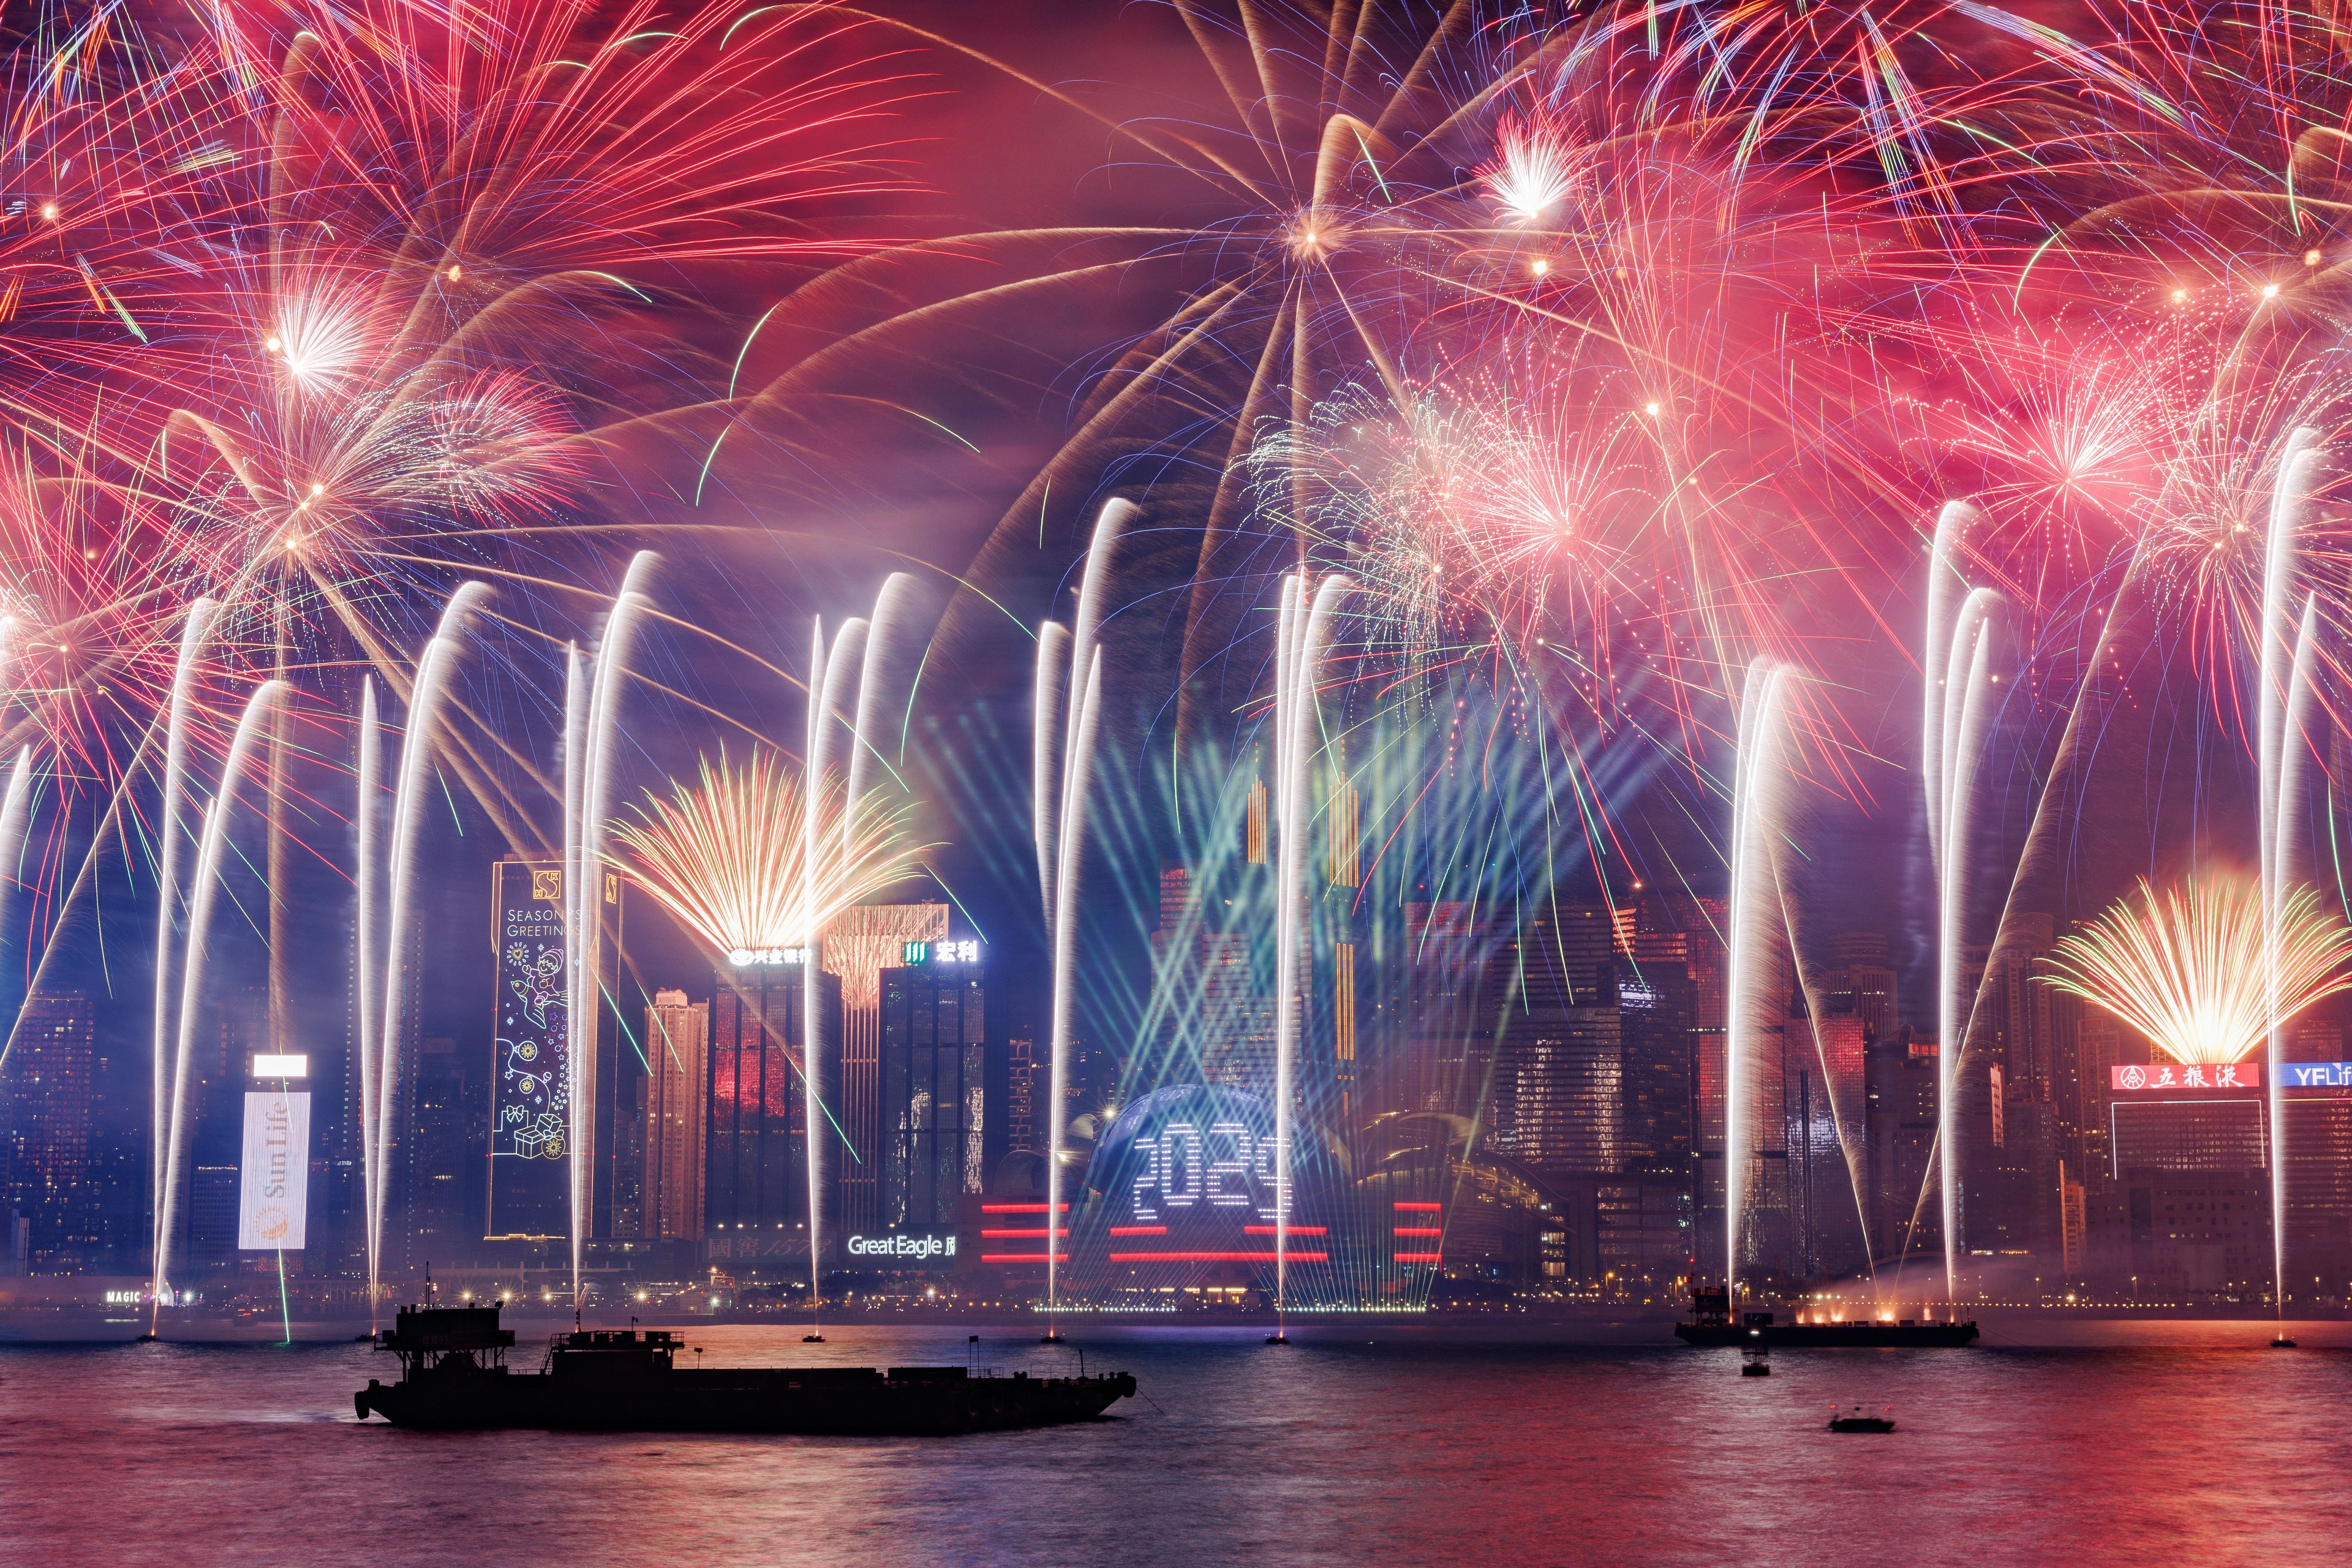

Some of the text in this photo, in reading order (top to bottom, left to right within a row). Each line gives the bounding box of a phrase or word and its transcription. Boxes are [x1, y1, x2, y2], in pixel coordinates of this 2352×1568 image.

[507, 924, 581, 937] GREETINGS
[936, 940, 977, 962] 宏利
[2149, 1064, 2245, 1088] 五粮液
[2294, 1063, 2352, 1086] YFLif
[265, 1102, 287, 1198] Sun Life
[1133, 1123, 1293, 1219] 2025
[848, 1235, 895, 1254] Great
[896, 1235, 943, 1259] Eagle
[107, 1292, 140, 1302] MAGIC
